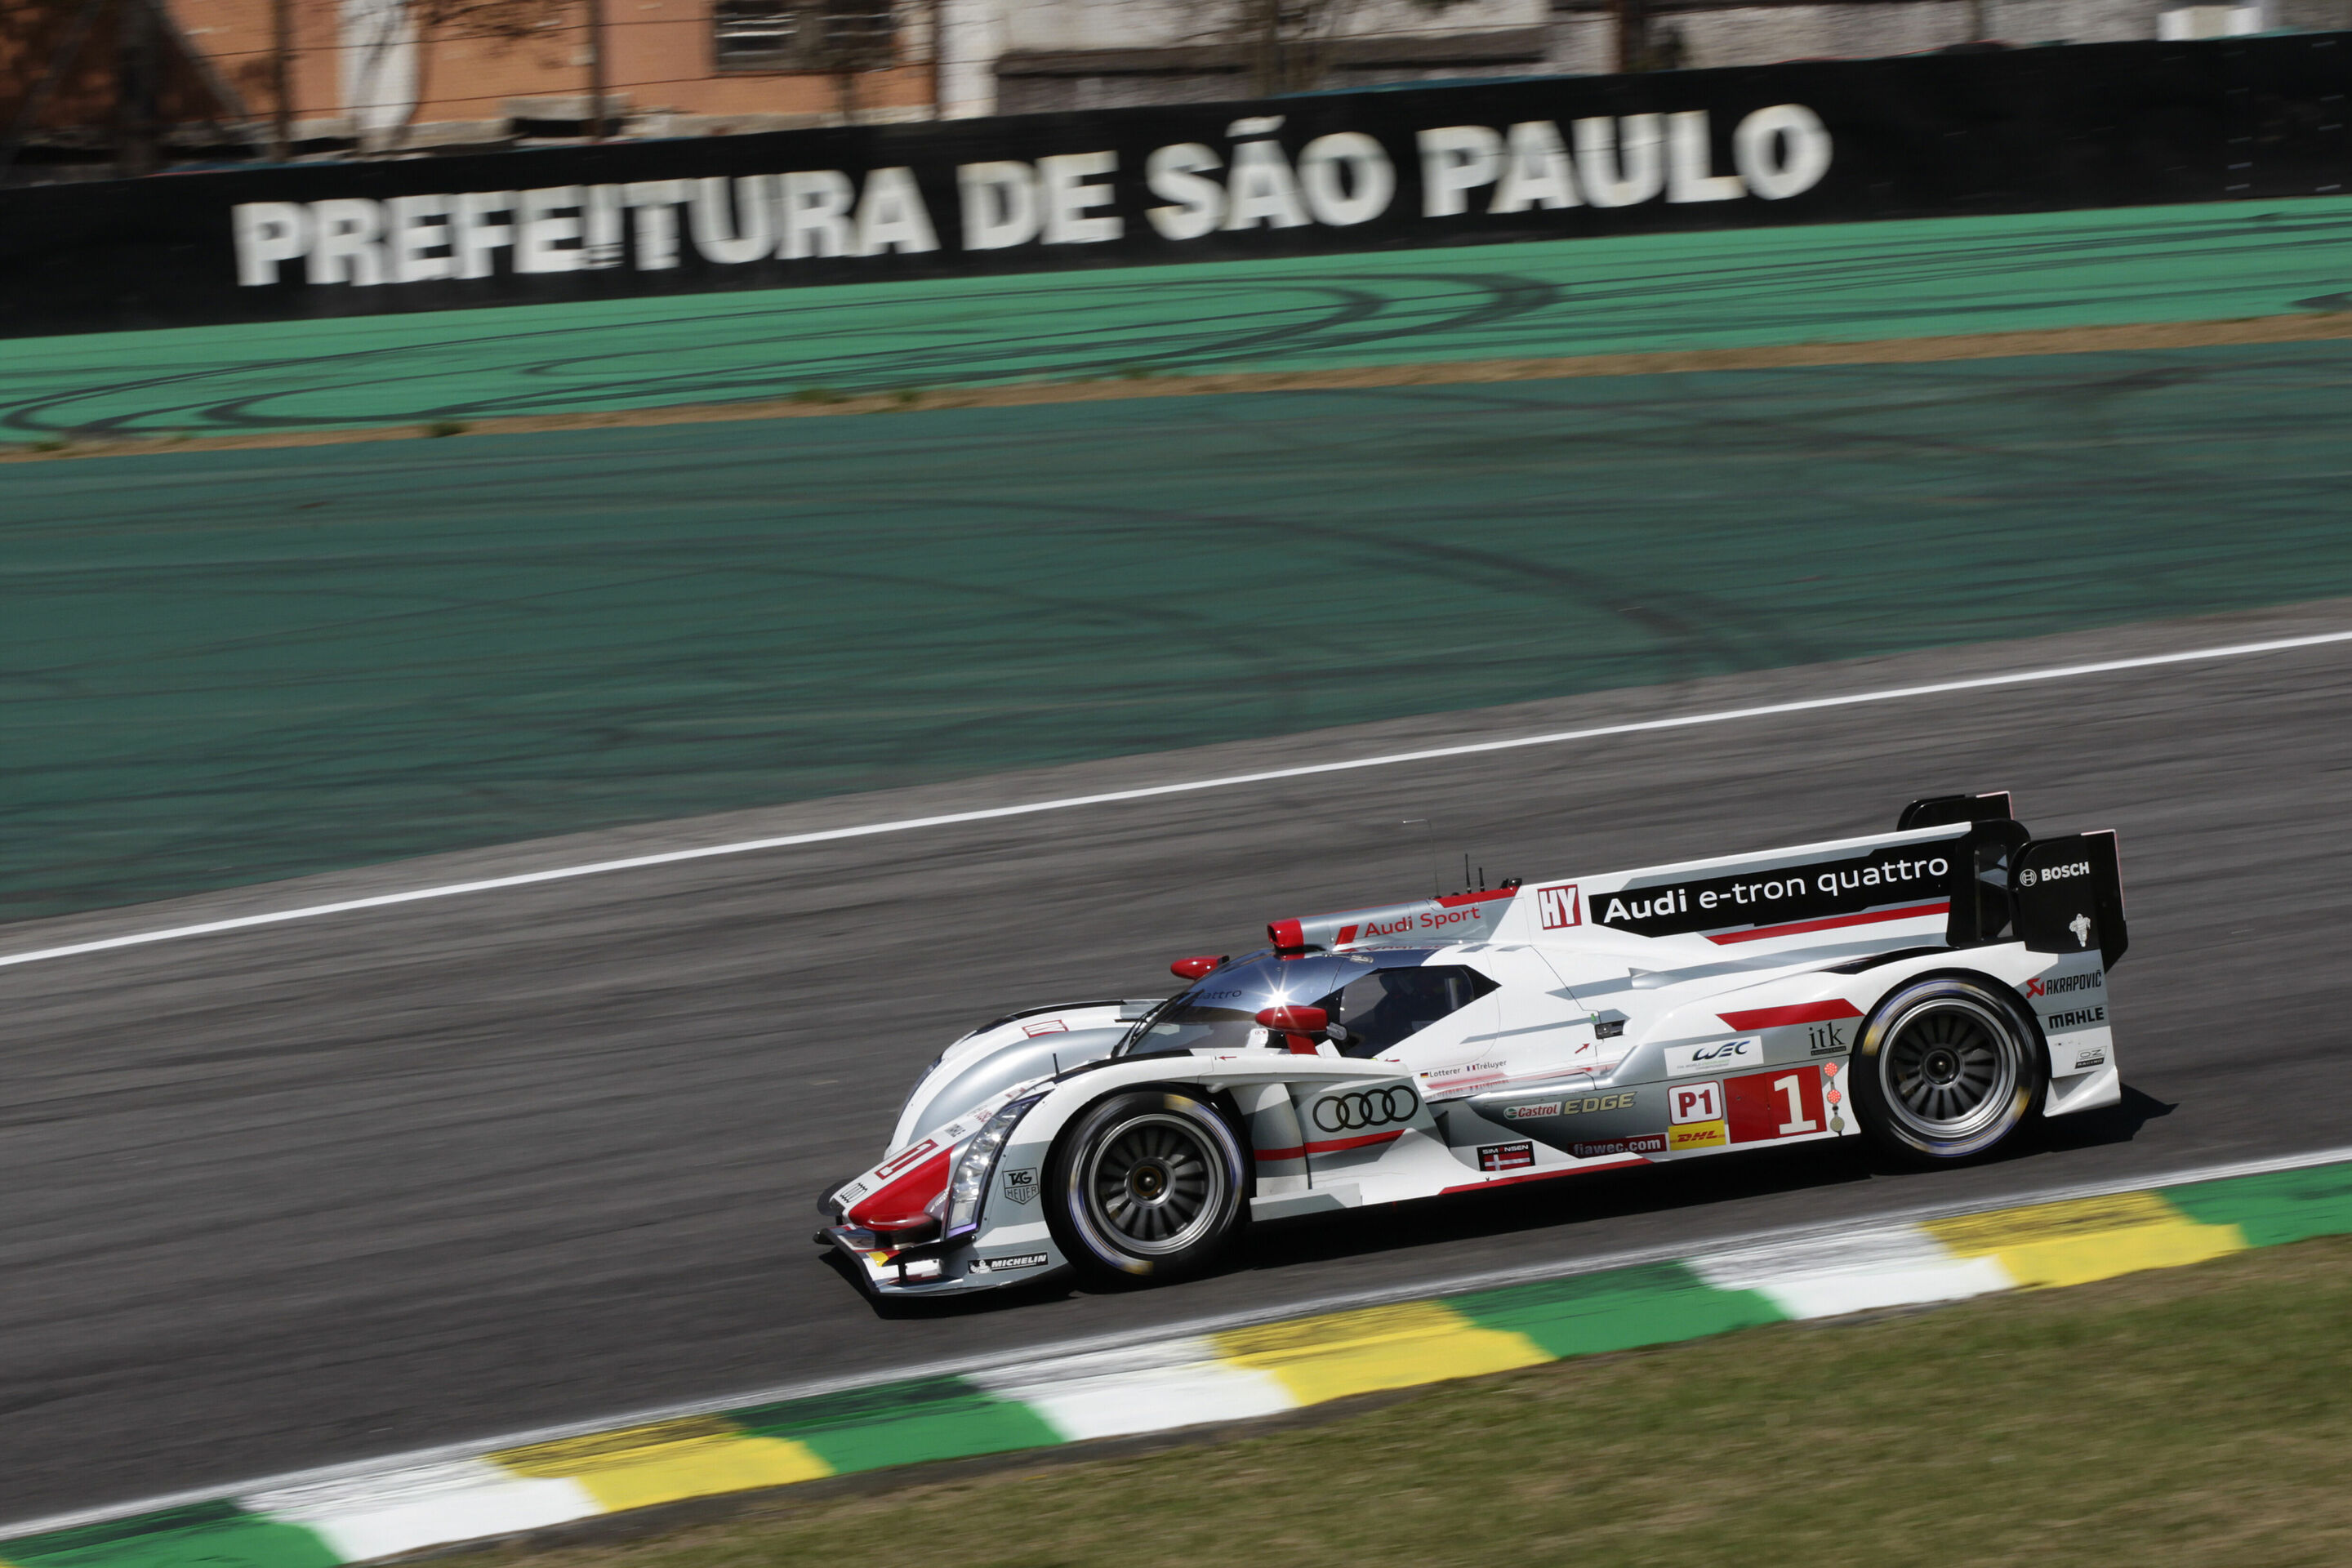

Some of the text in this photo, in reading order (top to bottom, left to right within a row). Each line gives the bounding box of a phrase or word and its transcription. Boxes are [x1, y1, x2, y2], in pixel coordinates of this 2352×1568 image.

[232, 104, 1833, 287] PREFEITURA DE SÃO PAULO
[2041, 862, 2090, 881] BOSCH
[1603, 857, 1949, 924] Audi e-tron quattro
[1539, 887, 1578, 929] HY
[1365, 906, 1481, 938] Audi Sport
[2048, 1007, 2105, 1029] MAHLE
[1808, 1022, 1846, 1049] itk
[1692, 1040, 1750, 1061] WEC
[1429, 1067, 1461, 1078] Lotterer
[1518, 1092, 1637, 1118] Castrol EDGE
[1678, 1089, 1713, 1117] P1
[1773, 1074, 1817, 1134] 1
[1573, 1138, 1661, 1156] fiawec.com
[1677, 1130, 1717, 1142] DHL
[1009, 1171, 1032, 1185] TAG
[1007, 1186, 1036, 1201] HEUER
[991, 1254, 1046, 1268] MICHELIN
